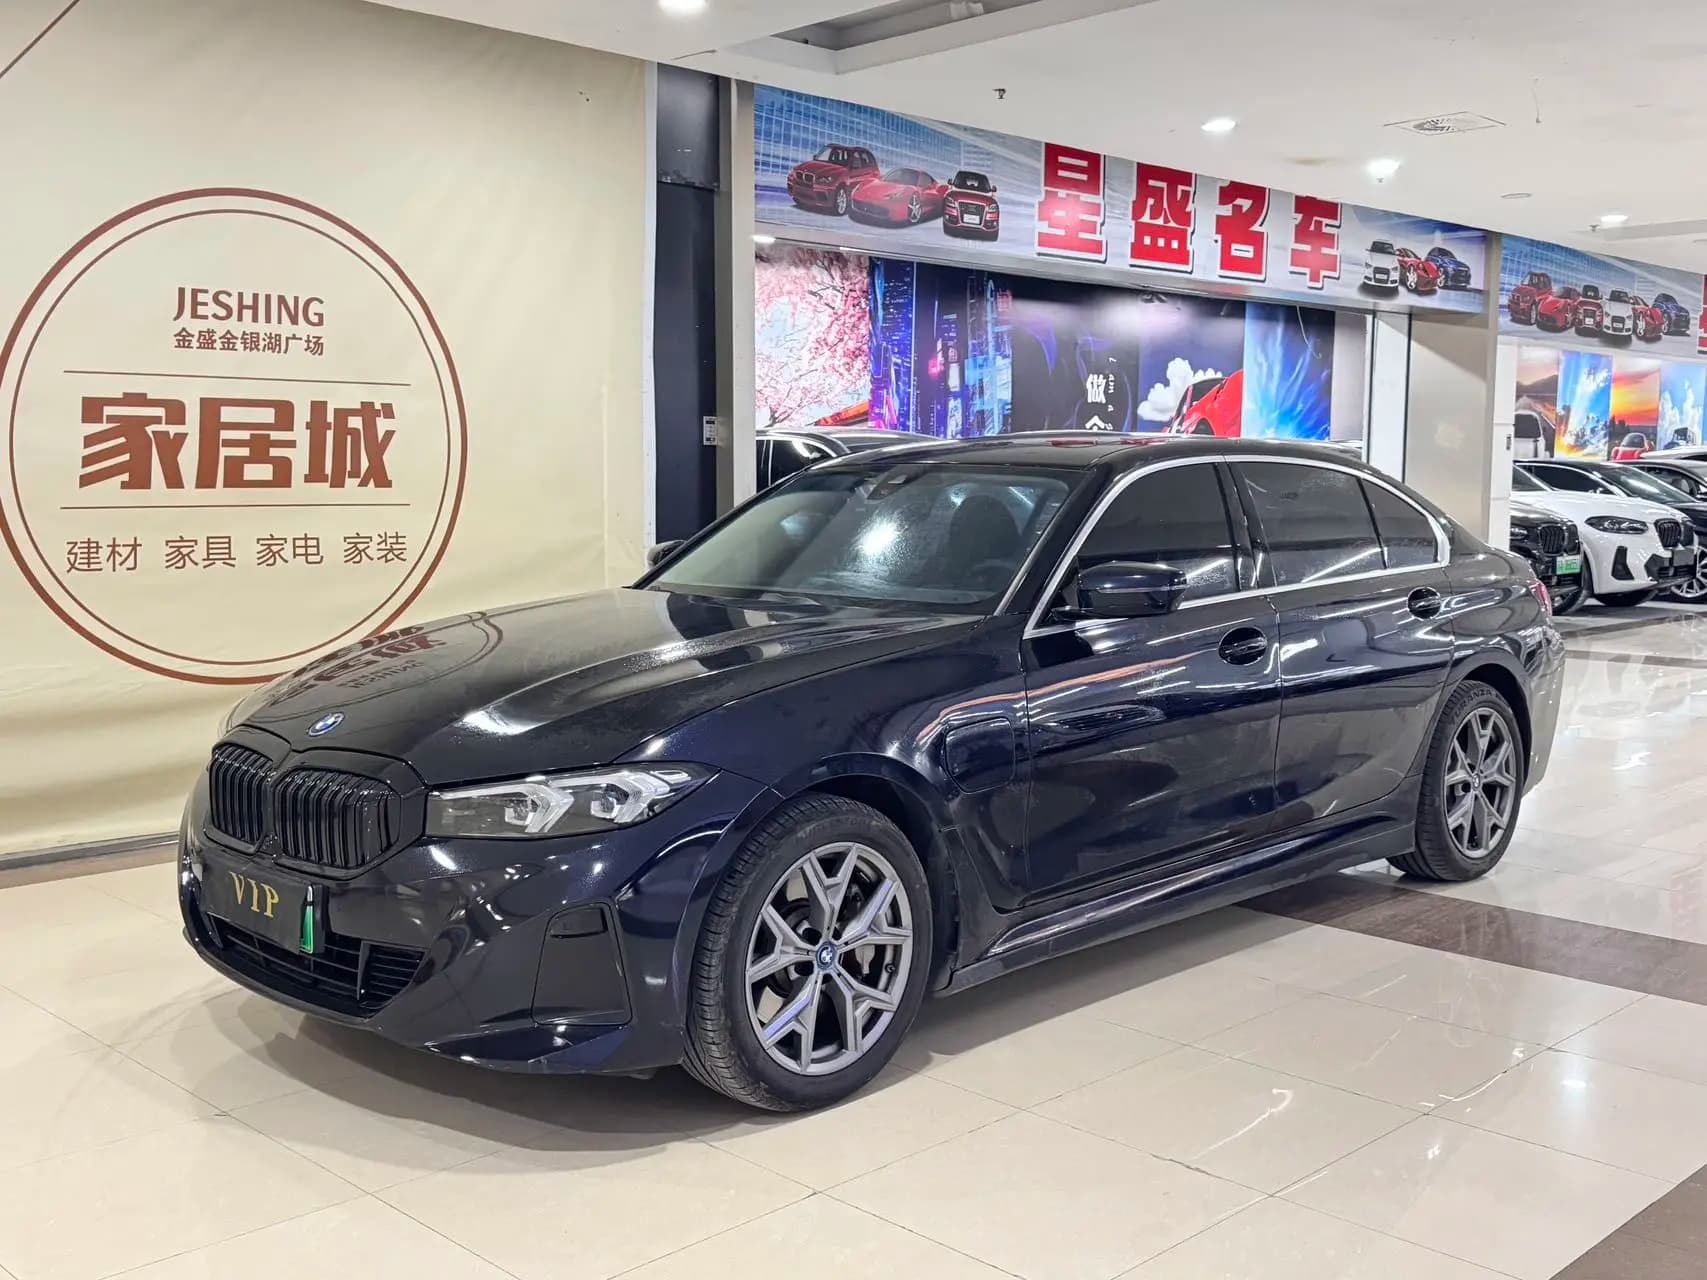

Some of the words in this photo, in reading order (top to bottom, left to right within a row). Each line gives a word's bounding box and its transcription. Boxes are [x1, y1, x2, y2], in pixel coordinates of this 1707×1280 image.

[1037, 142, 1341, 288] 星盛名车
[173, 287, 325, 327] JESHING
[173, 328, 325, 356] 金盛金银湖广场
[79, 392, 396, 489] 家居城
[66, 536, 143, 574] 建材
[164, 535, 237, 570] 家具
[256, 532, 324, 567] 家电
[343, 531, 408, 565] 家装
[229, 871, 279, 918] VIP
